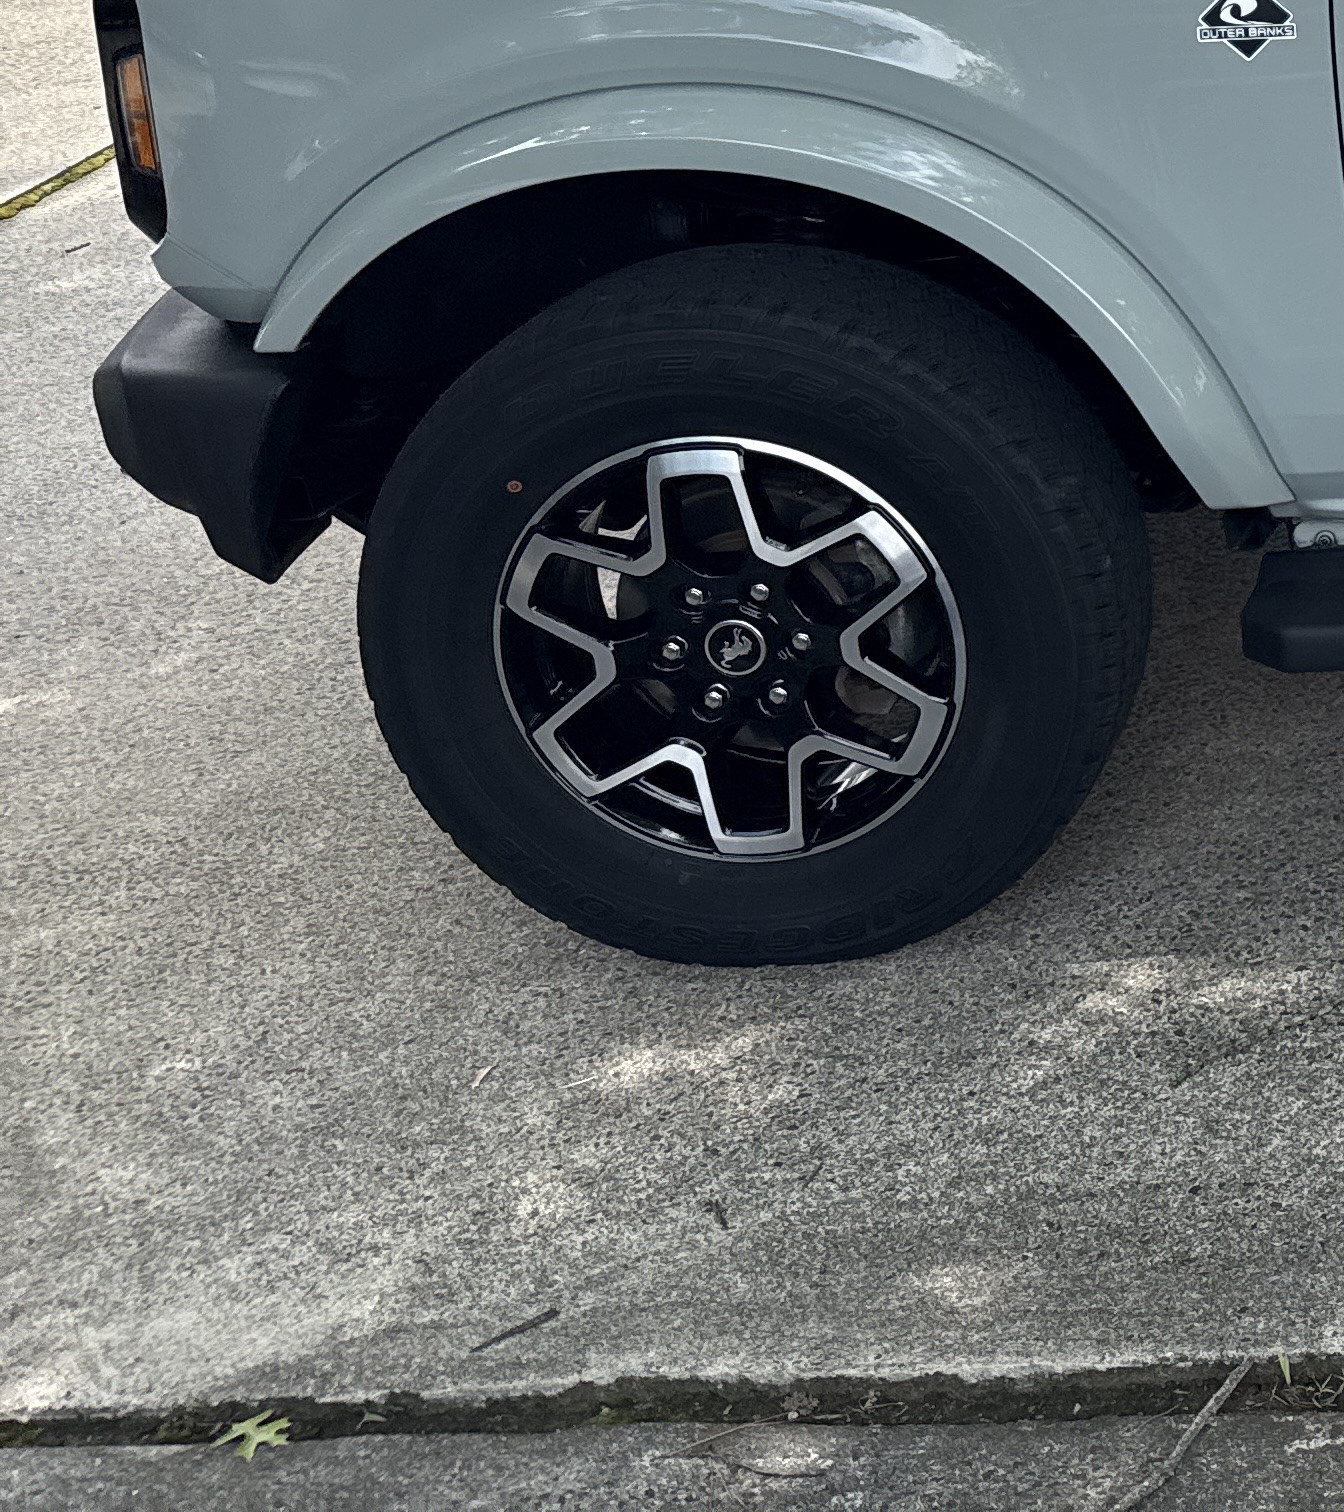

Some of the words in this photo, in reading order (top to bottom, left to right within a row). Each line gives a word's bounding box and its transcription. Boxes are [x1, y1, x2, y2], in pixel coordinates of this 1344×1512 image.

[1201, 28, 1245, 39] OUTER
[1249, 26, 1293, 36] BANKS
[499, 346, 908, 440] DUELER
